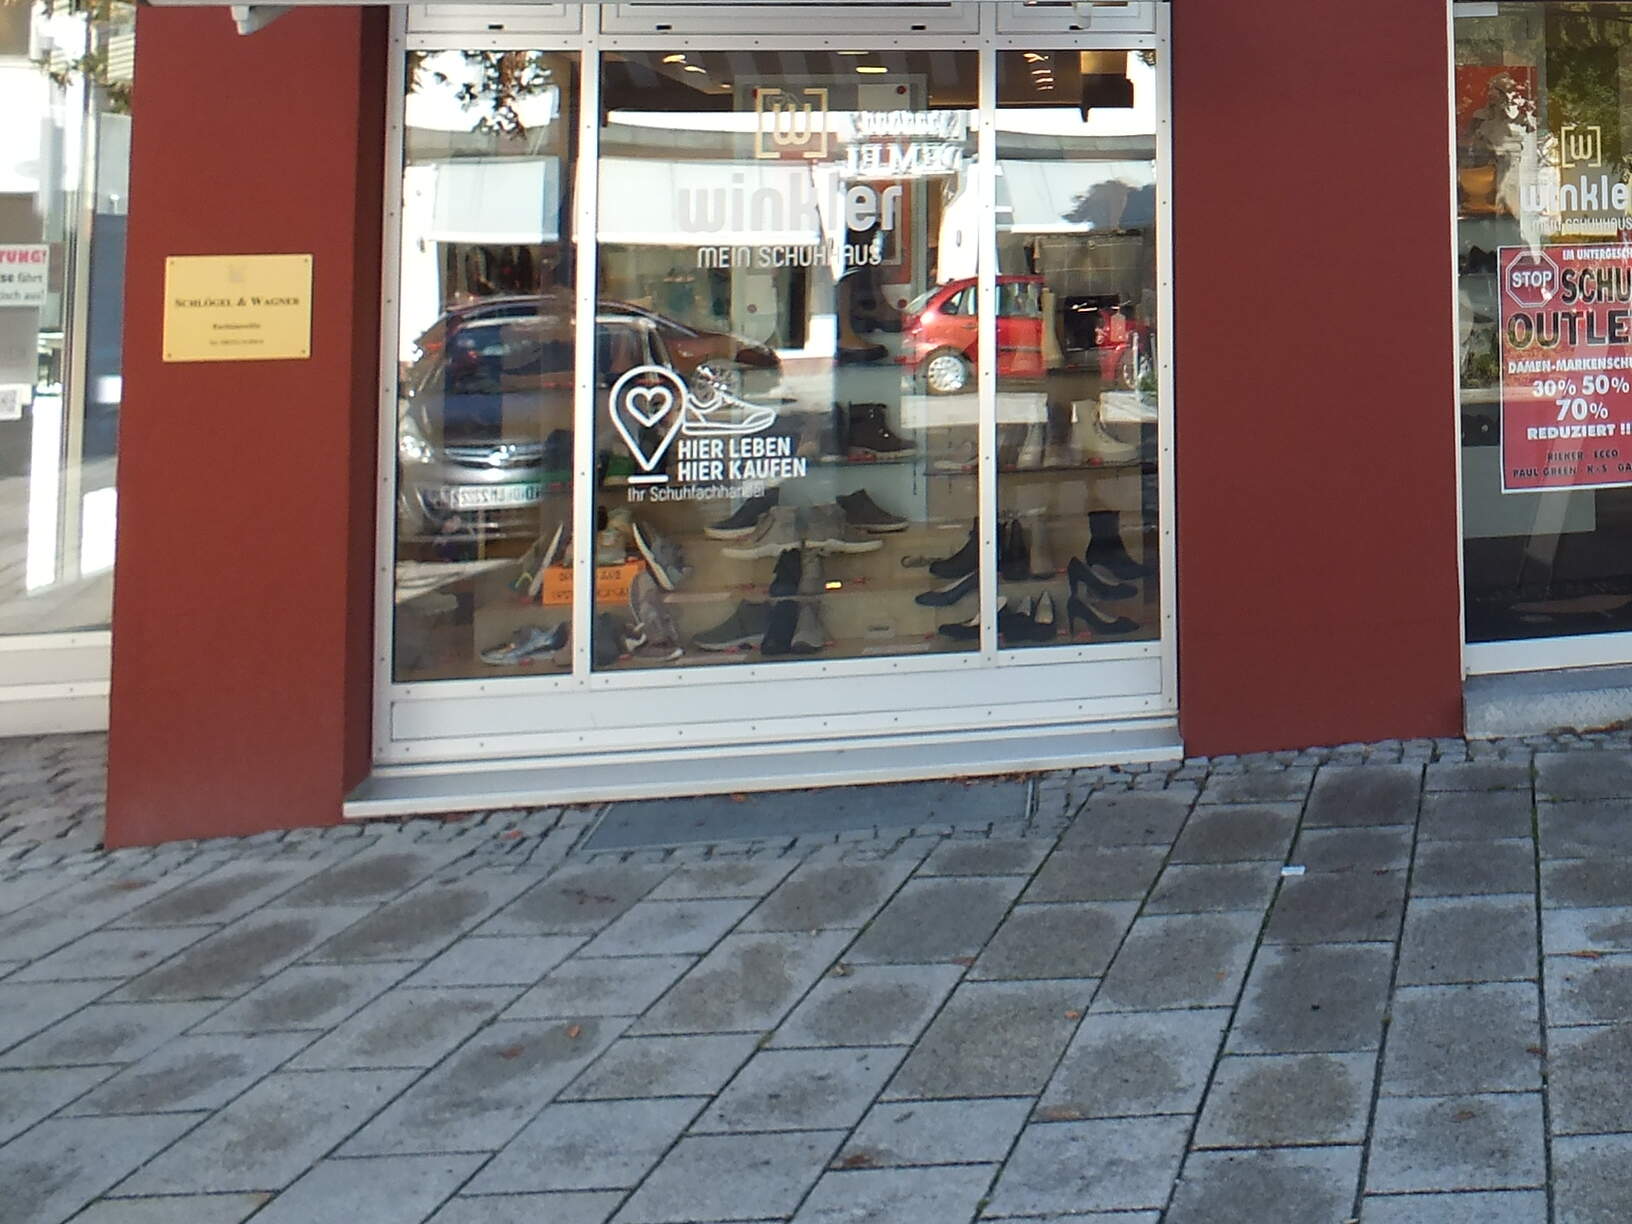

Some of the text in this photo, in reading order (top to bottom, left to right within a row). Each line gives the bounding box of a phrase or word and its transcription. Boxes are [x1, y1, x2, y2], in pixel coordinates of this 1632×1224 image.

[677, 173, 902, 233] winkler
[697, 244, 882, 269] MEIN SCHUHHAUS
[1512, 270, 1552, 288] STOP
[1532, 375, 1630, 397] 30% 50%
[1555, 398, 1609, 421] 70%
[1527, 423, 1616, 440] REDUZIERT
[678, 437, 791, 460] HIER LEBEN
[678, 457, 806, 482] HIER KAUFEN
[627, 479, 767, 503] Ihr Schuhfachhandel
